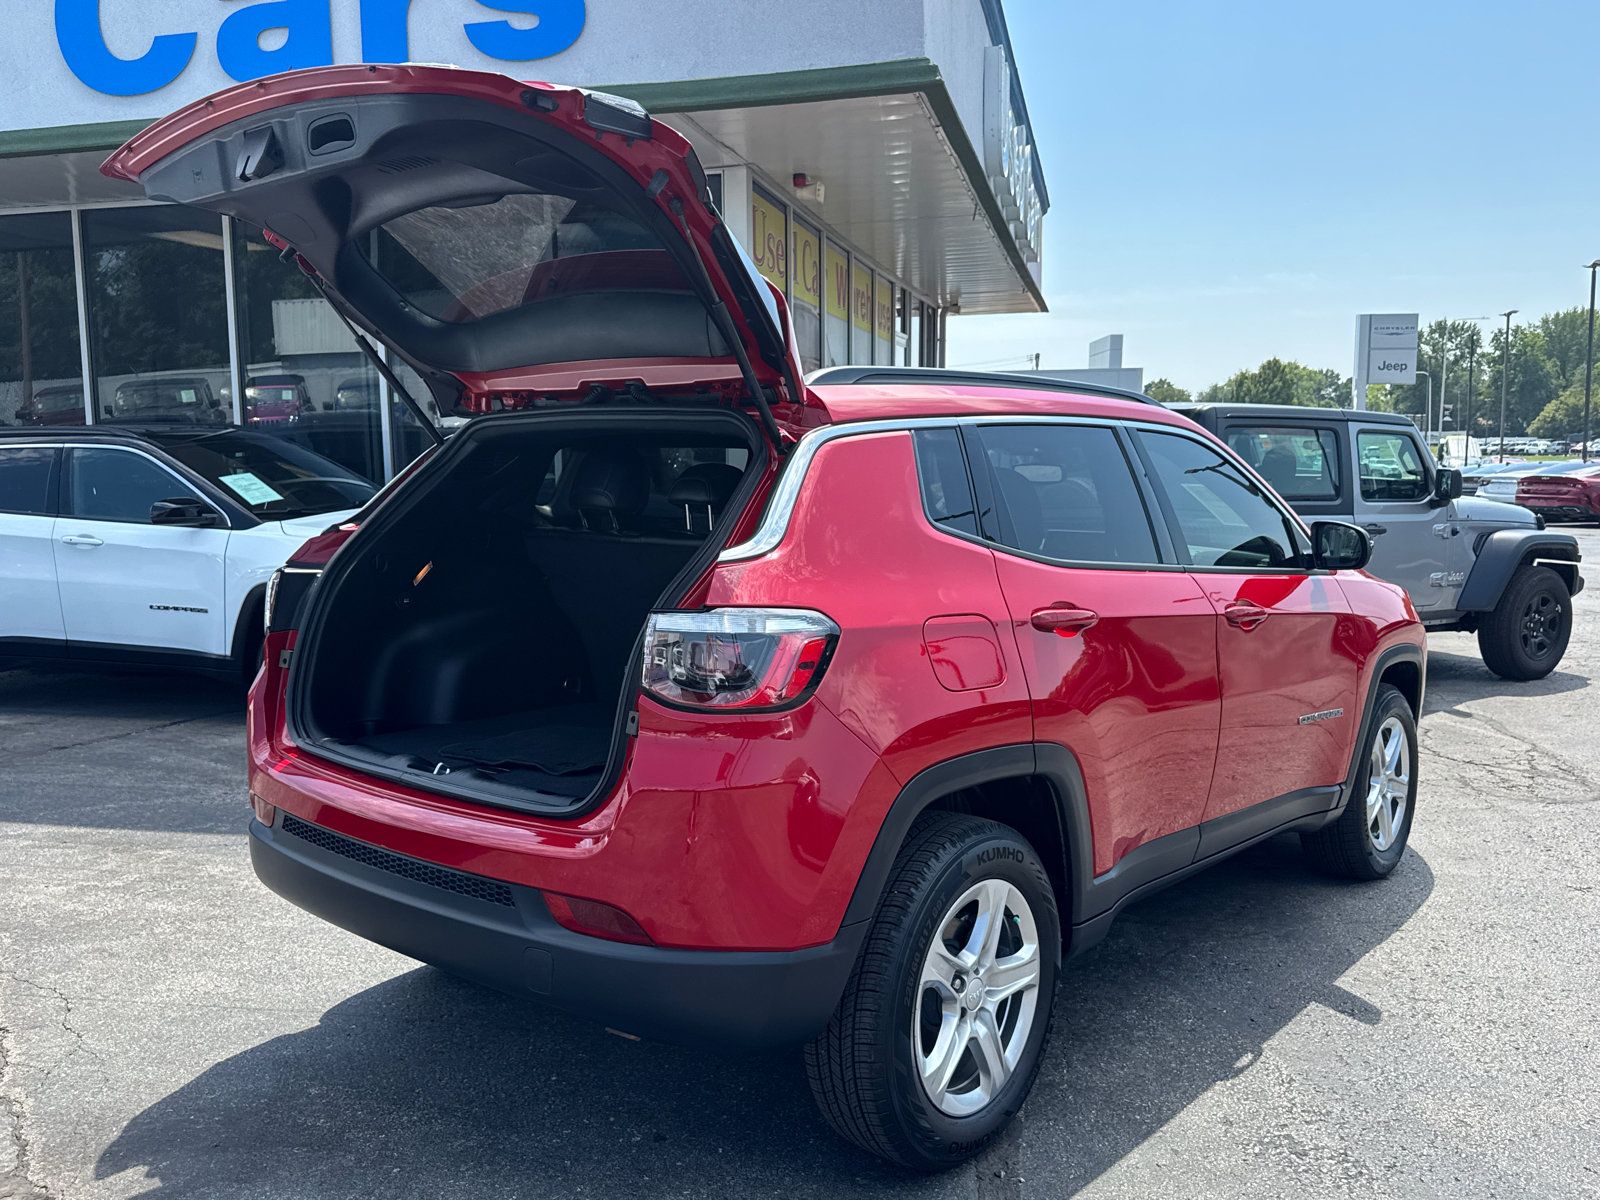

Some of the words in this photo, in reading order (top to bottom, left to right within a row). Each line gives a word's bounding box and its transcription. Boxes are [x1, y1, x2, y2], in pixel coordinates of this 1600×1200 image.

[802, 239, 829, 297] Ca
[836, 262, 891, 336] Wrehuse
[1377, 360, 1408, 373] Jeep
[149, 604, 209, 614] COMPASS
[976, 846, 1025, 866] KUMHO
